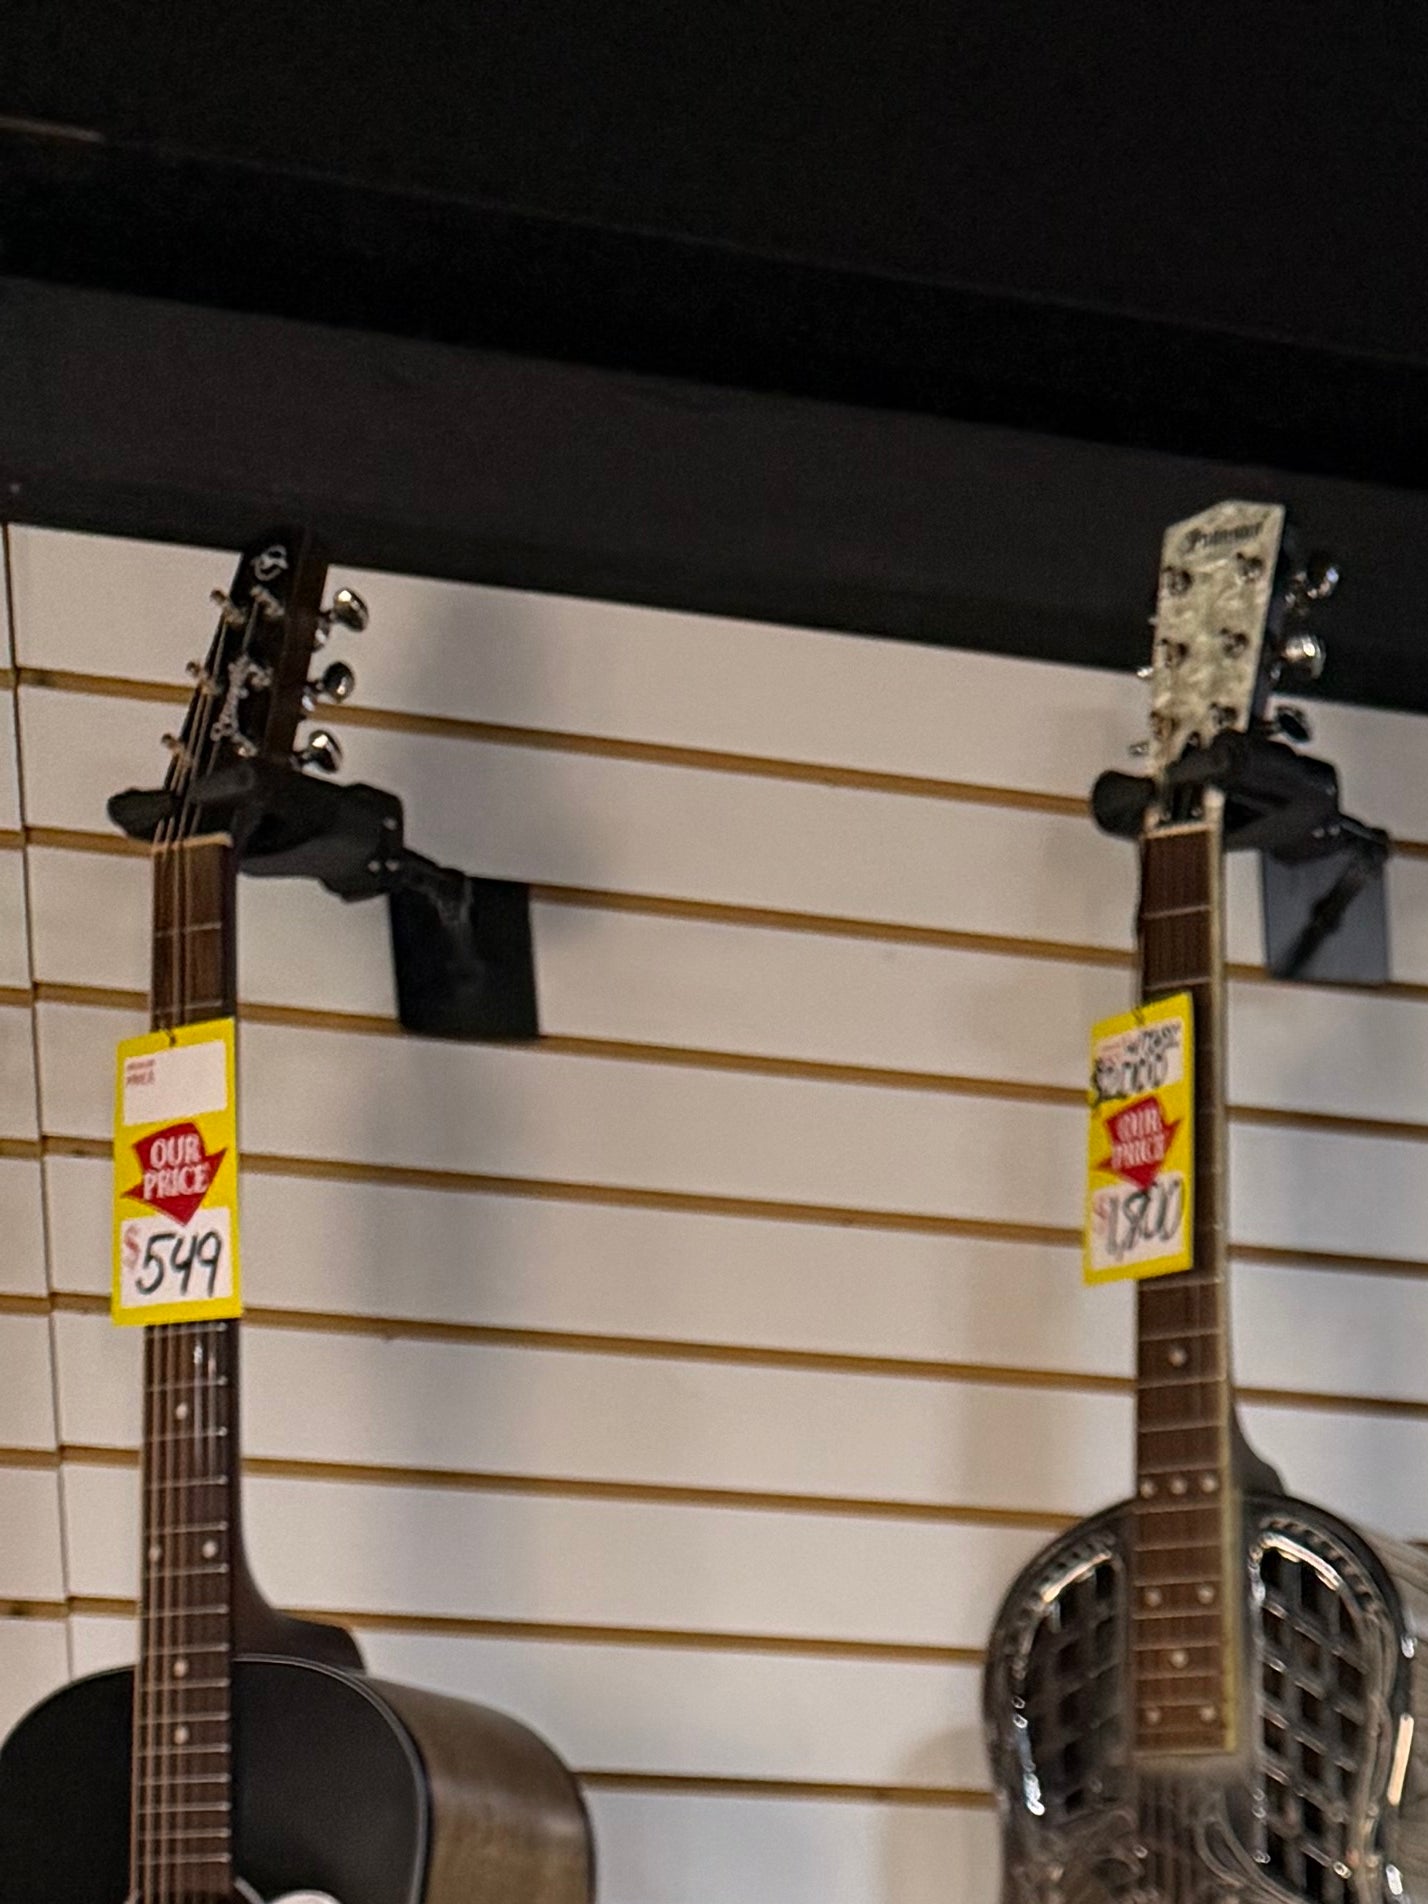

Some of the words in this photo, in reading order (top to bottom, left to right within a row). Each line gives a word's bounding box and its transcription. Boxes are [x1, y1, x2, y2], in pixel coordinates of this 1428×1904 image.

[1116, 1106, 1163, 1144] OUR
[150, 1133, 201, 1170] OUR
[143, 1162, 211, 1200] PRICE
[122, 1225, 223, 1298] $549
